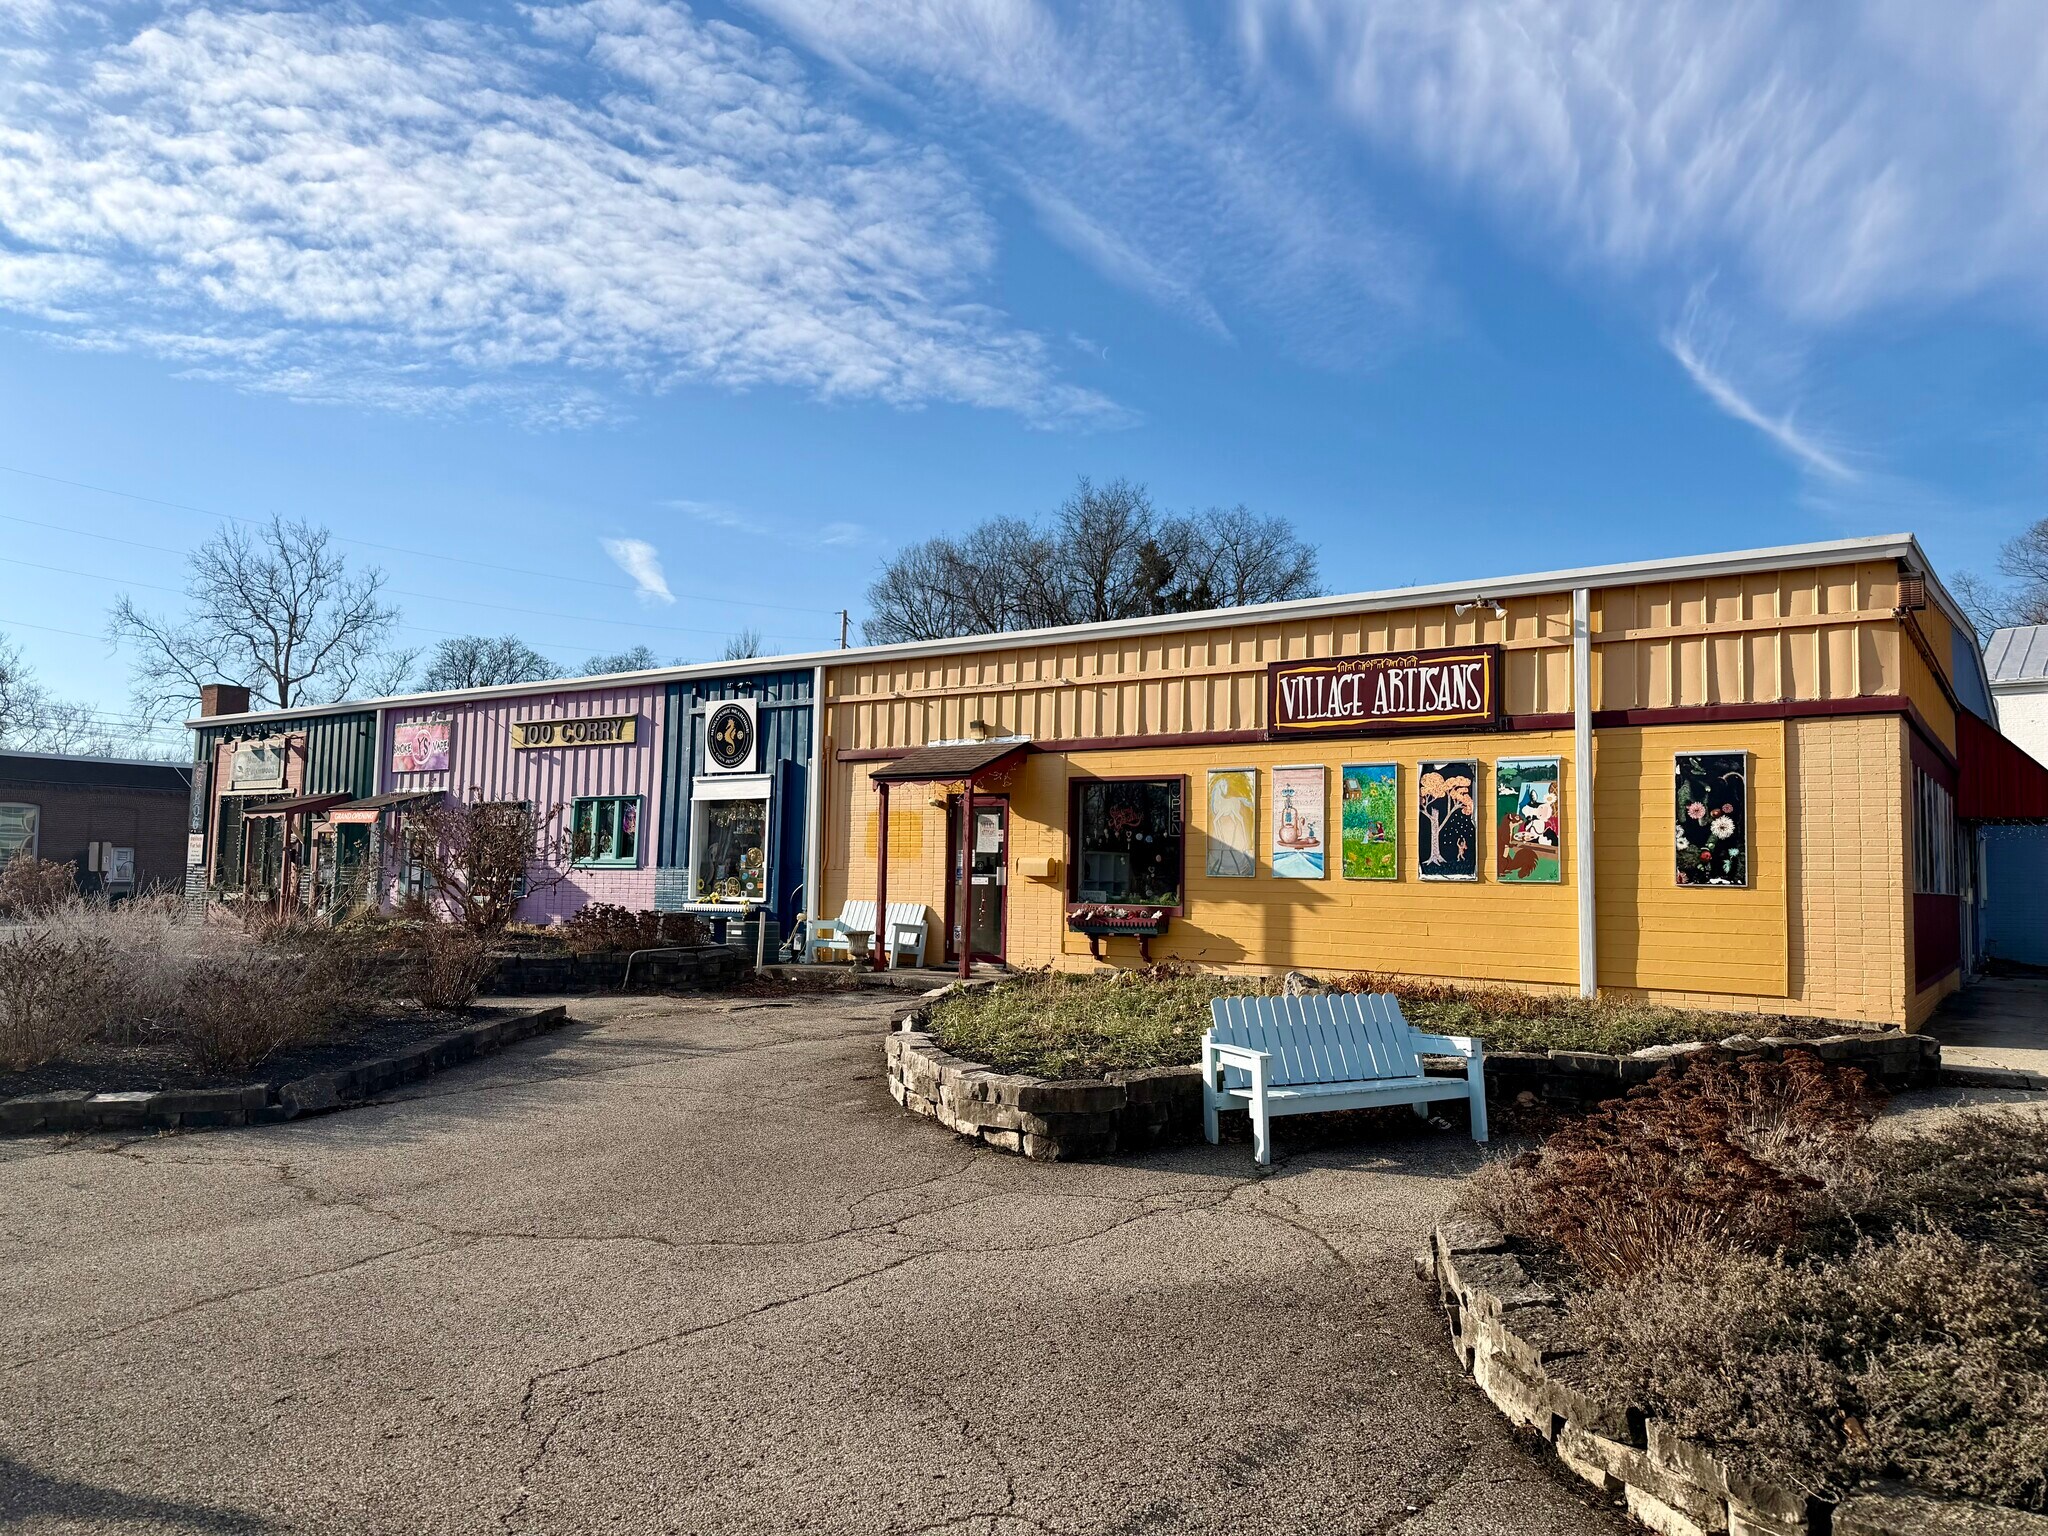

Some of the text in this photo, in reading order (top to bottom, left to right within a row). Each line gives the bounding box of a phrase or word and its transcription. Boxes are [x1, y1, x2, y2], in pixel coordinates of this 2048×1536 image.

[1280, 663, 1481, 719] VILLAGE ARTISANS
[522, 720, 623, 745] 100 CORRY
[417, 736, 430, 756] YS
[432, 740, 449, 752] VAPE
[334, 811, 374, 821] GRAND OPENING
